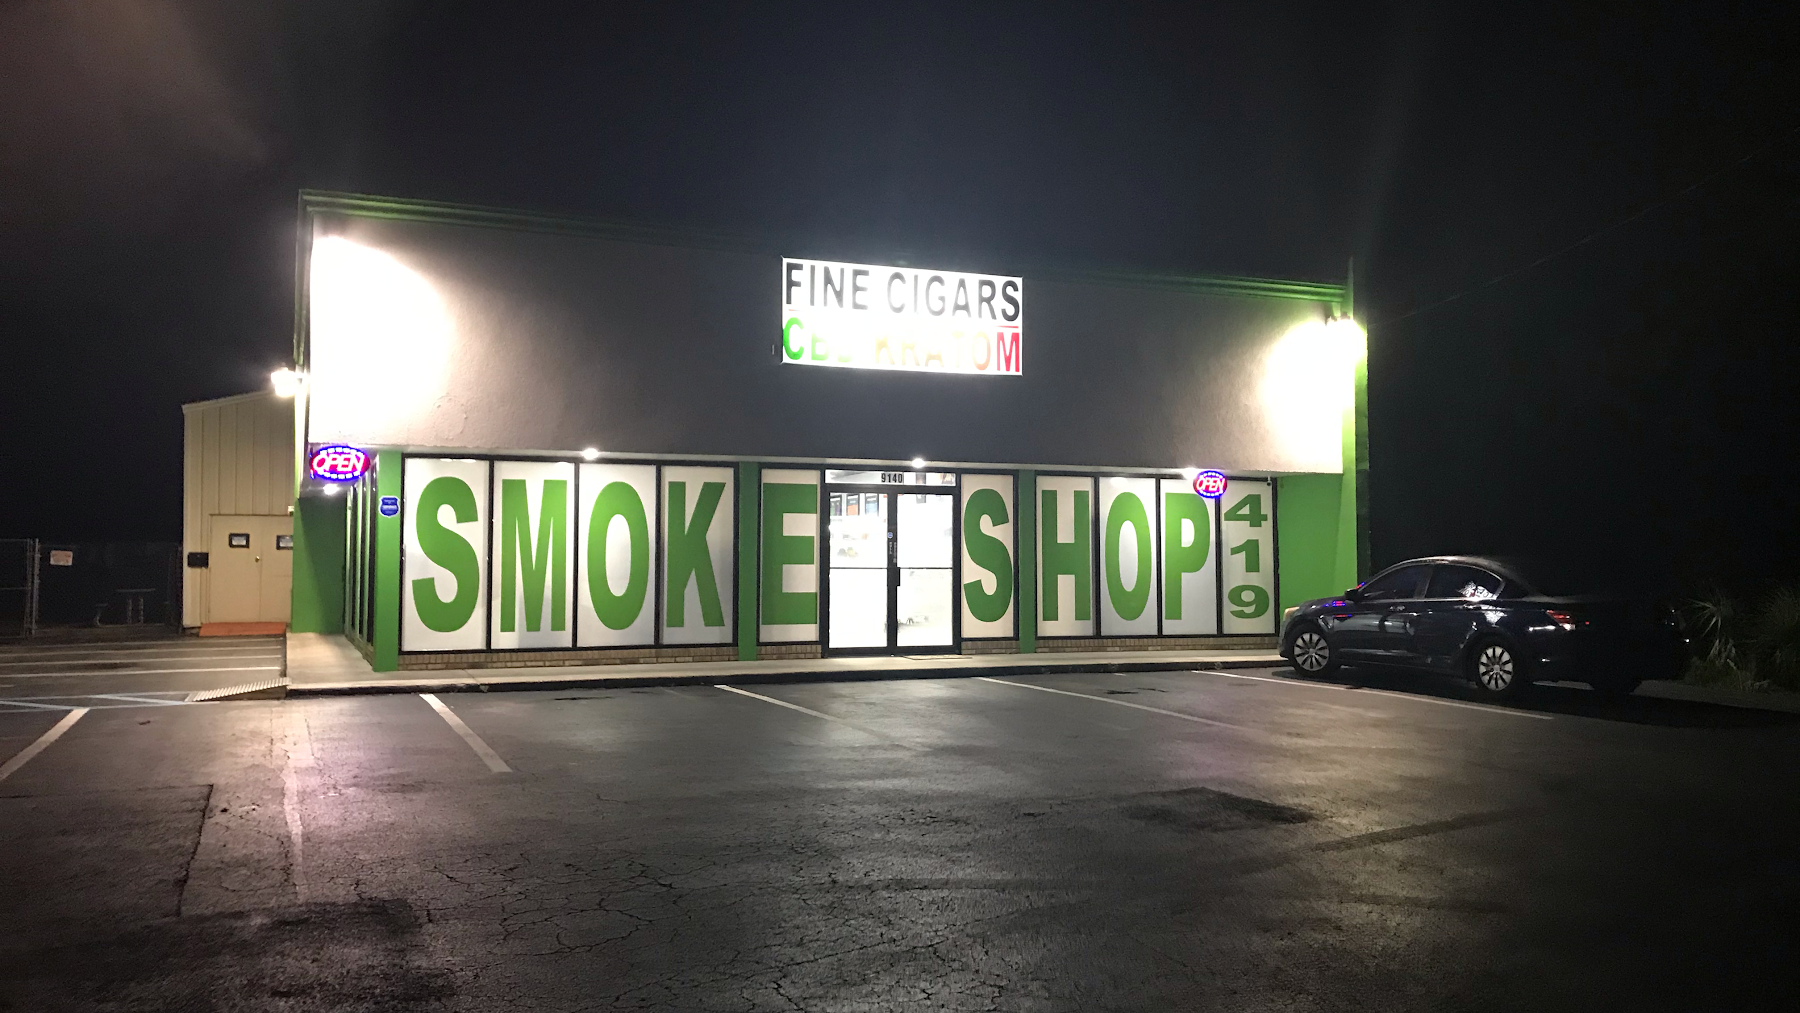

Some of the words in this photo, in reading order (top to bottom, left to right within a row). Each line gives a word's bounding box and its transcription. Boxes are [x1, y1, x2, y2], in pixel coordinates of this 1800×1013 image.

[786, 262, 870, 310] FINE
[887, 272, 1020, 322] CIGARS
[783, 317, 855, 363] CB
[312, 453, 366, 474] OPEN
[881, 473, 903, 483] 9140
[1196, 476, 1226, 492] OPEN
[412, 476, 818, 633] SMOKE
[963, 488, 1211, 622] SHOP
[1224, 494, 1270, 619] 419
